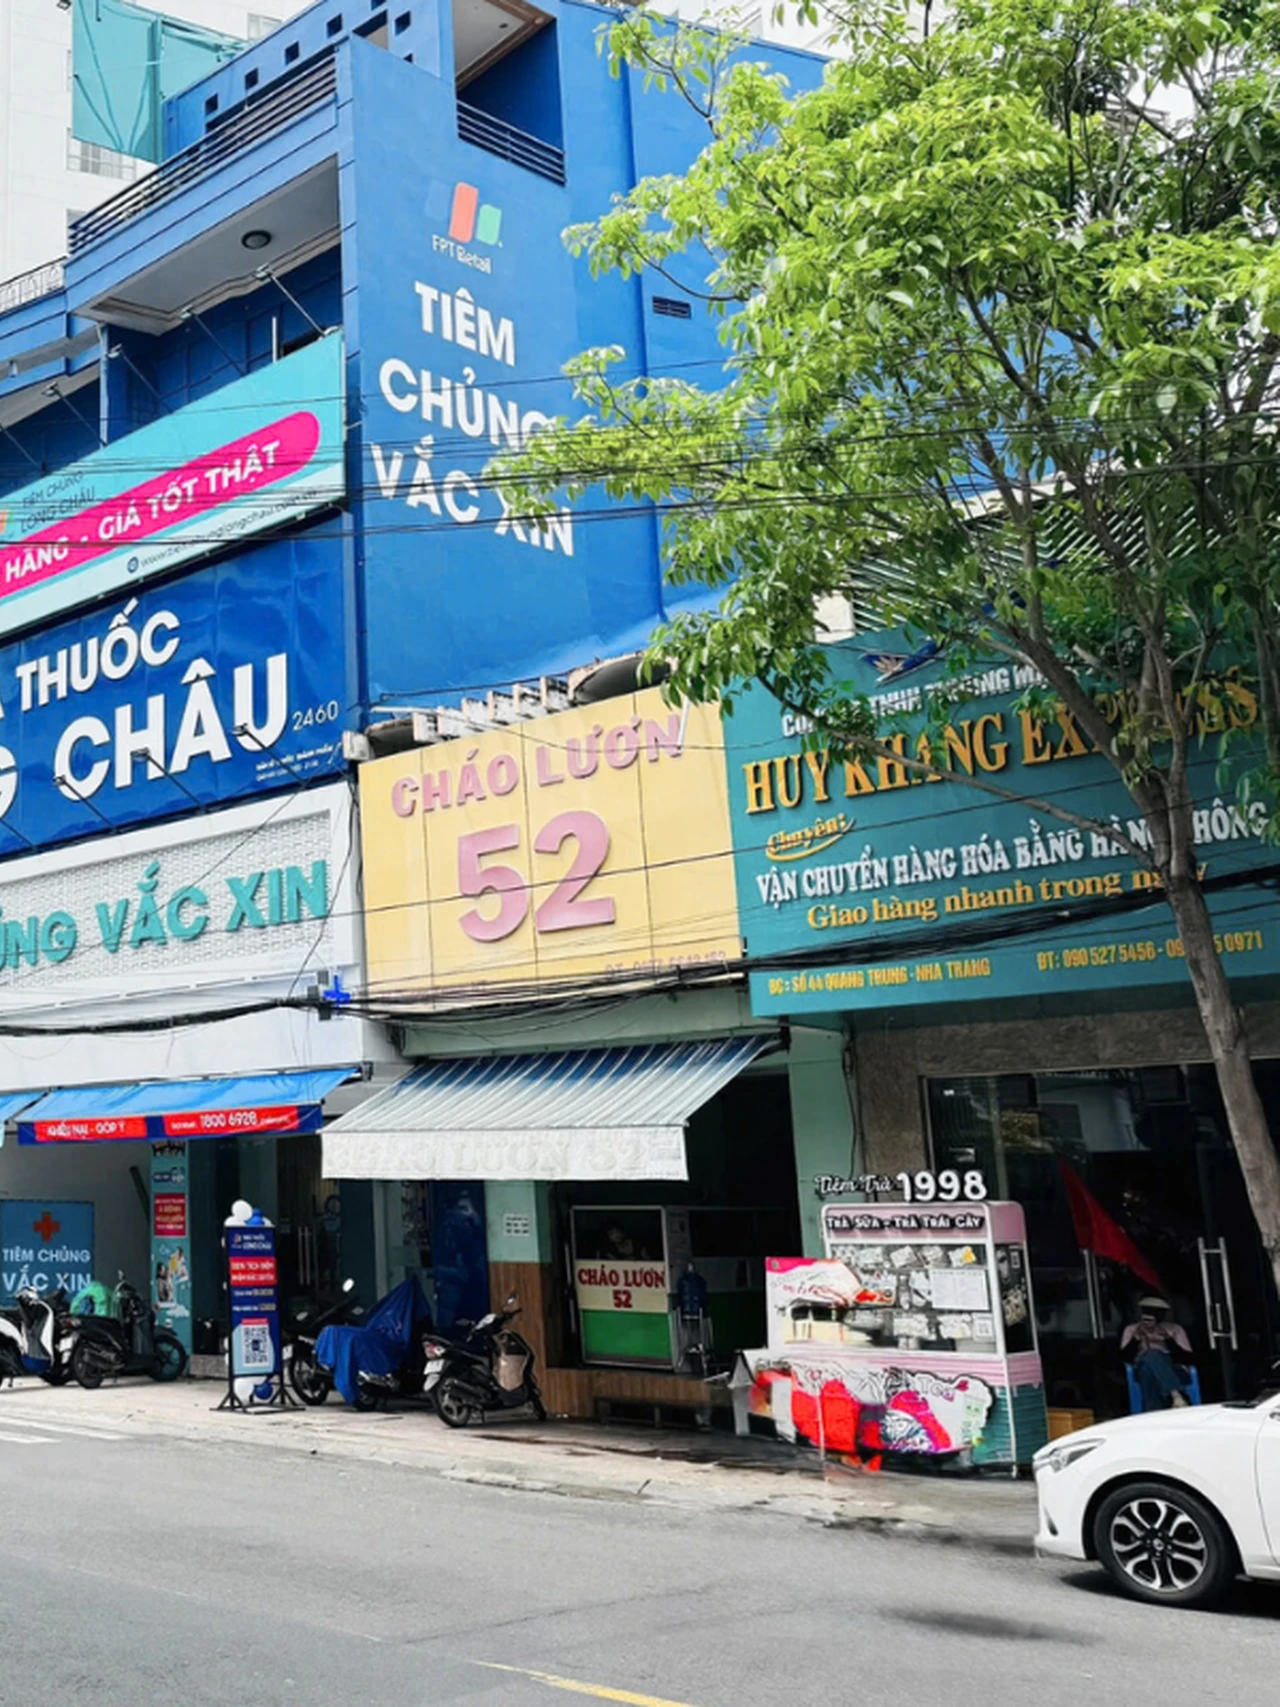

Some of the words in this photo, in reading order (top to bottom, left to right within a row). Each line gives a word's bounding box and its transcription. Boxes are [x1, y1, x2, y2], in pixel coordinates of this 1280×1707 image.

[431, 233, 455, 258] FPT
[414, 280, 515, 367] TIÊM
[5, 536, 71, 582] HÃNG
[97, 497, 142, 543] GIÁ
[147, 473, 199, 520] TỐT
[204, 441, 281, 497] THẬT
[370, 434, 480, 524] VẮC
[494, 485, 574, 557] XIN
[16, 597, 180, 712] THUỐC
[54, 653, 287, 802] CHÂU
[291, 699, 339, 732] 2460
[391, 749, 520, 818] CHÁO
[535, 714, 683, 787] LƯƠN
[742, 748, 832, 815] HUY
[844, 712, 1009, 798] KHANG
[458, 810, 616, 944] 52
[756, 866, 799, 911] VẬN
[801, 844, 888, 897] CHUYỂN
[892, 845, 957, 885] HÀNG
[960, 833, 1010, 877] HÓA
[1013, 818, 1085, 869] BẰNG
[1090, 814, 1156, 859] HÀN
[1191, 797, 1270, 844] HÔNG
[95, 860, 209, 953] VẮC
[225, 858, 329, 933] XIN
[807, 903, 869, 931] Giao
[872, 895, 939, 923] hàng
[944, 880, 1036, 915] nhanh
[1038, 871, 1124, 902] trong
[825, 970, 865, 992] QUANG
[868, 967, 909, 987] TRUNG
[915, 962, 943, 983] NHA
[946, 957, 991, 979] TRANG
[1090, 944, 1118, 966] 527
[200, 1111, 226, 1128] 1800
[228, 1111, 258, 1127] 6928
[897, 1169, 988, 1201] 1998
[2, 1245, 34, 1262] TIÊM
[37, 1245, 91, 1263] CHỦNG
[826, 1215, 850, 1228] TRÀ
[853, 1214, 881, 1228] SỮA
[894, 1215, 919, 1228] TRÀ
[923, 1215, 952, 1228] TRÁI
[955, 1214, 984, 1228] CÂY
[2, 1264, 49, 1292] VẮC
[55, 1272, 92, 1293] XIN
[578, 1264, 620, 1287] CHÁO
[623, 1267, 666, 1289] LƯƠN
[612, 1289, 633, 1309] 52
